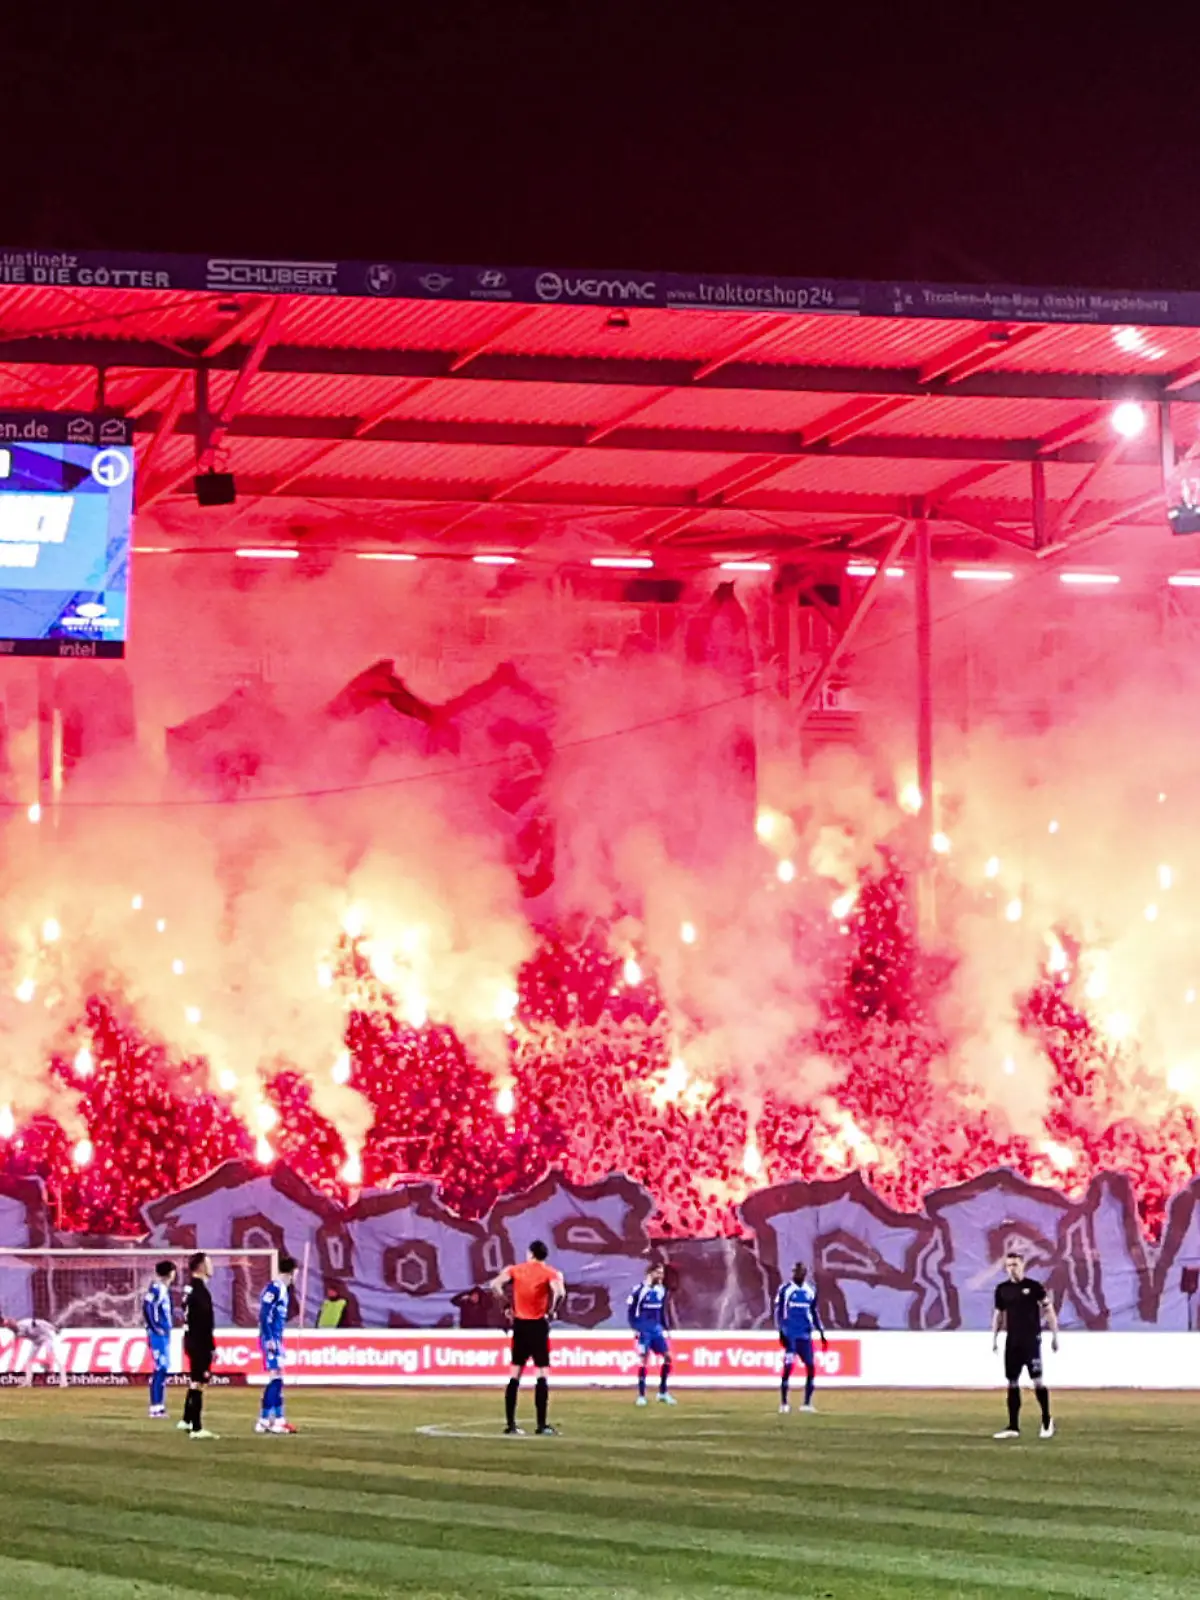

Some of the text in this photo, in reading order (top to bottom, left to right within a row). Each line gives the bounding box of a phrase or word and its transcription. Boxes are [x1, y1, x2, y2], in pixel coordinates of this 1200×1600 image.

[0, 252, 78, 268] ustinetz
[0, 266, 170, 287] IE DIE GÖTTER
[206, 259, 338, 285] SCHUBERT
[435, 1347, 498, 1367] Unser
[693, 1347, 723, 1368] Ihr
